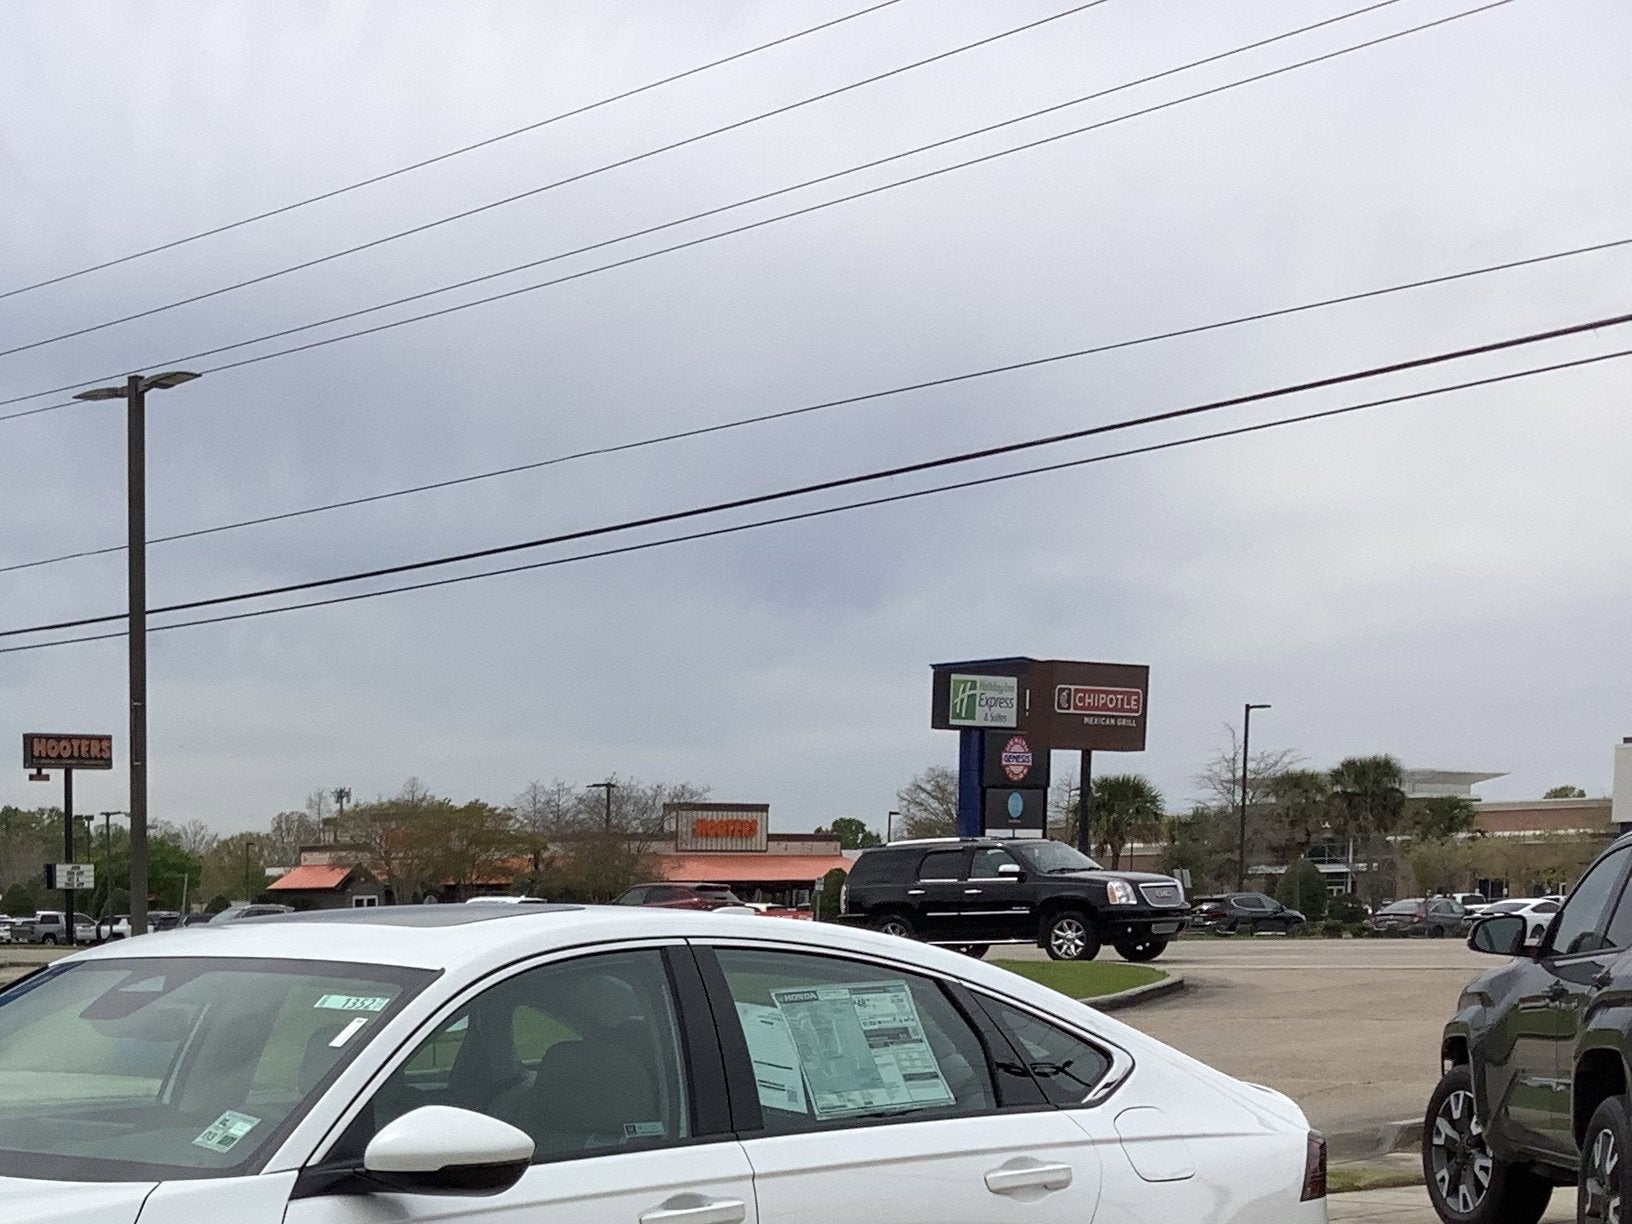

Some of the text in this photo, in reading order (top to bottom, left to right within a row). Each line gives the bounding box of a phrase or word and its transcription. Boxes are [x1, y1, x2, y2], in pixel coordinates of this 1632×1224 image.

[979, 692, 1015, 711] Express
[1075, 693, 1138, 709] CHIPOTLE
[1083, 716, 1137, 727] MEXICAN GRILL
[32, 738, 111, 759] HOOTERS
[1003, 754, 1031, 763] GENESIS
[694, 818, 758, 837] HOOTERS
[784, 992, 818, 1002] HONDA
